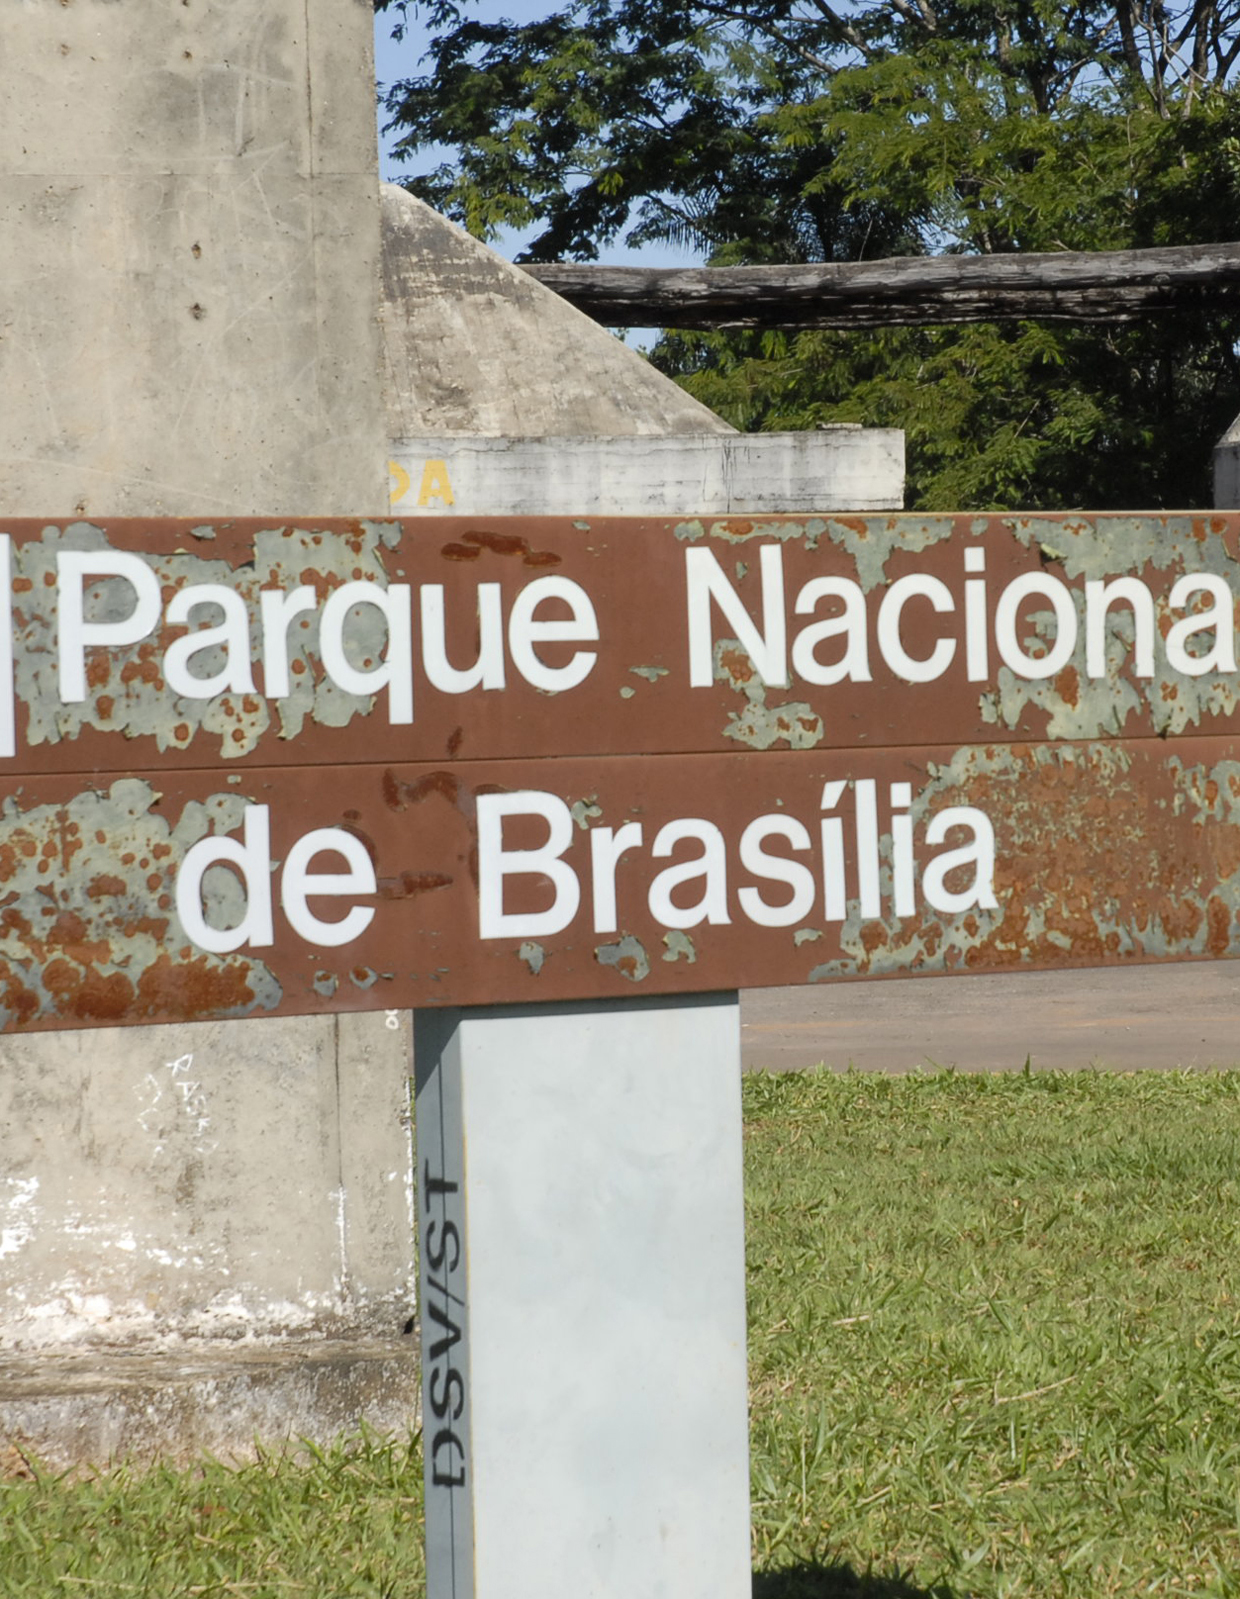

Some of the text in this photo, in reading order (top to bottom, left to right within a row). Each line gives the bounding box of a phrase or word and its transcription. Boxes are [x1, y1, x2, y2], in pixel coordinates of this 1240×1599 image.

[57, 550, 600, 724] Parque
[175, 778, 1000, 954] de Brasília
[424, 1158, 465, 1489] DSV/ST
